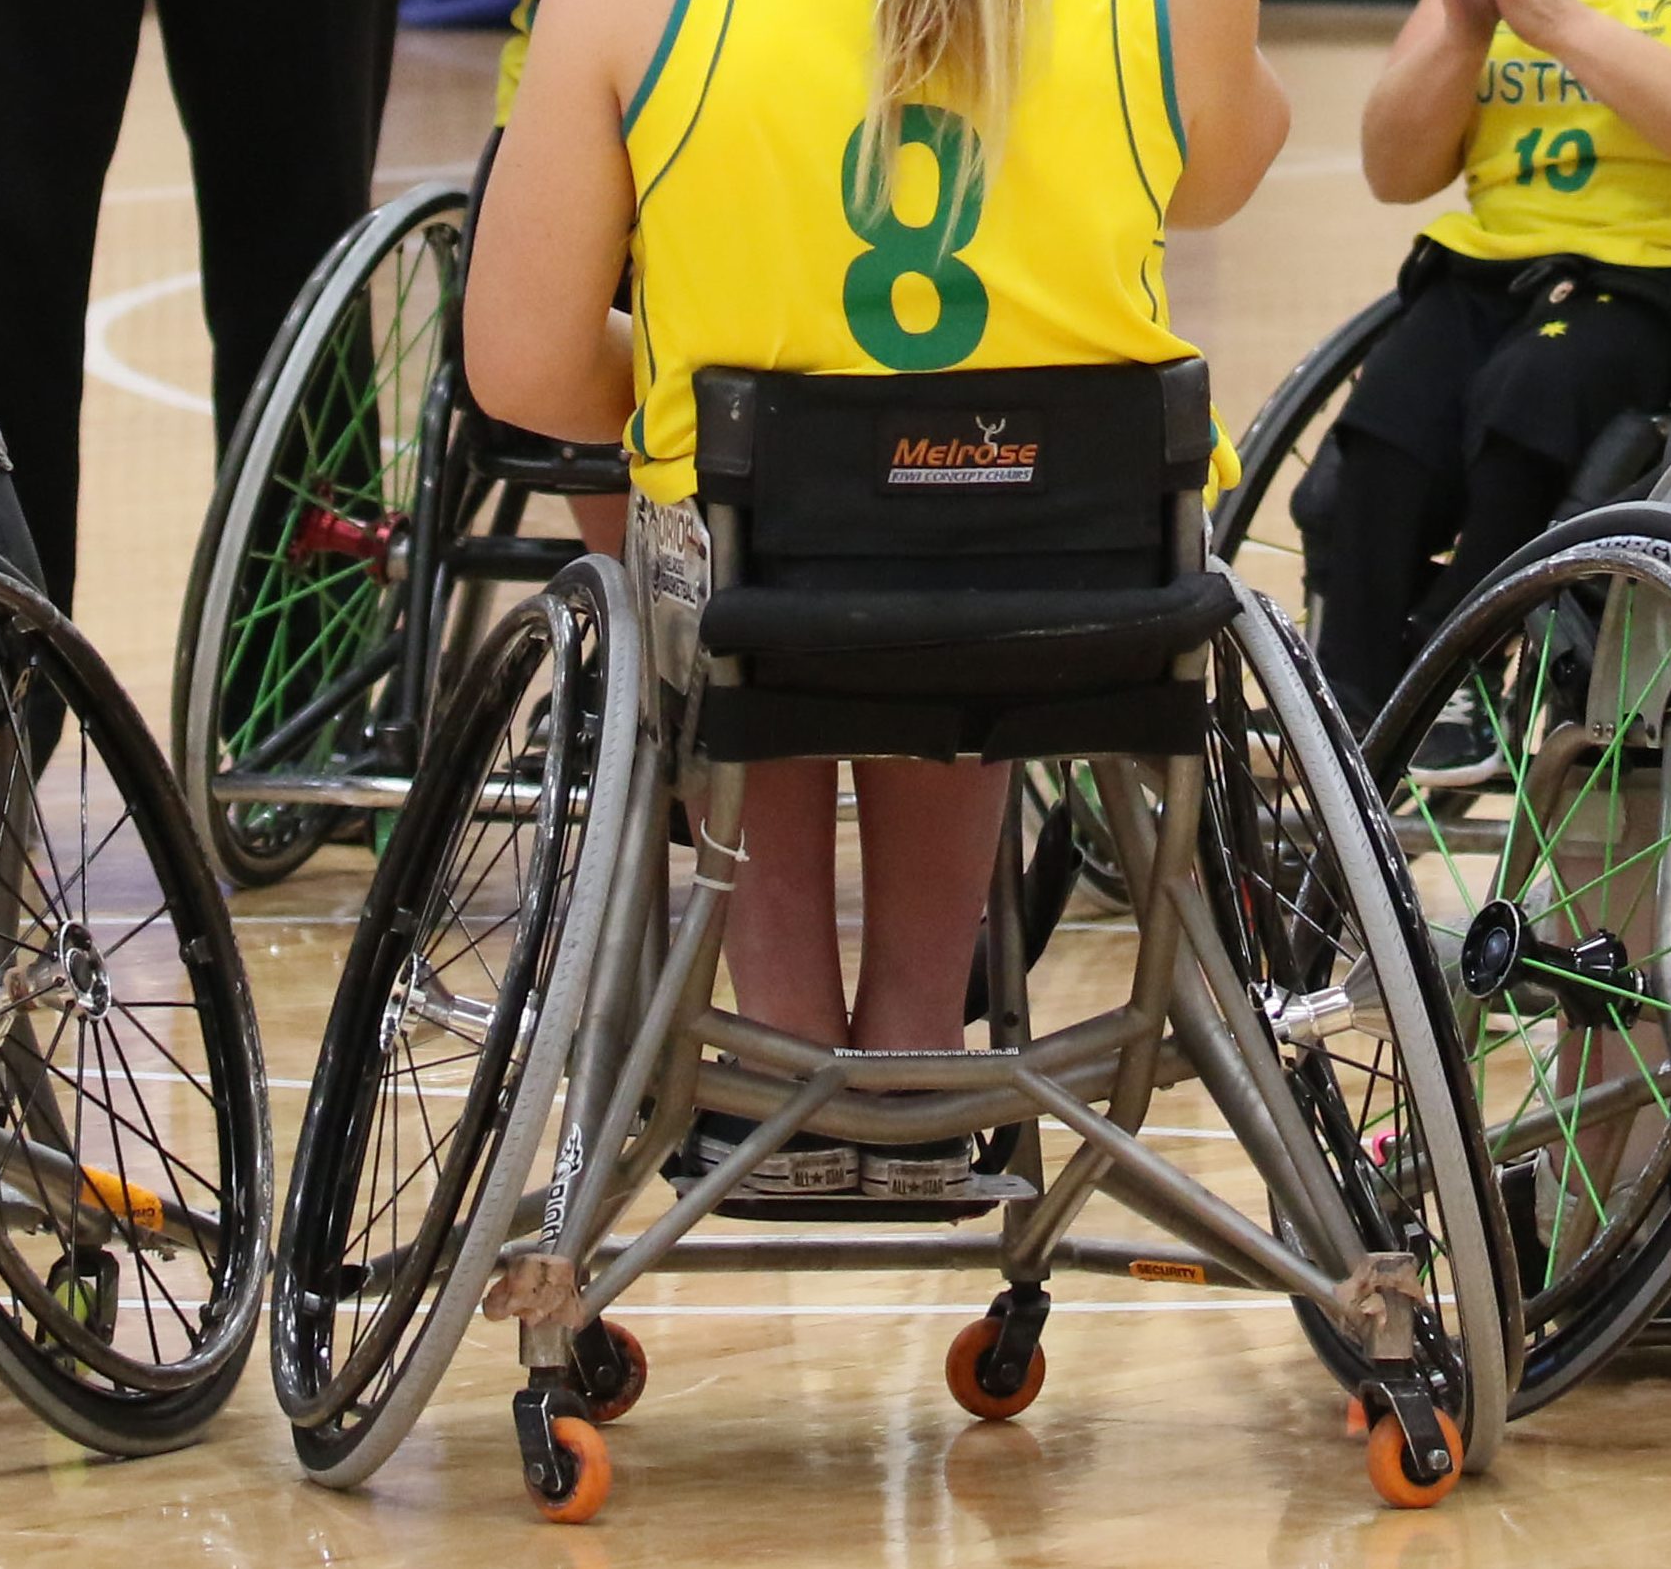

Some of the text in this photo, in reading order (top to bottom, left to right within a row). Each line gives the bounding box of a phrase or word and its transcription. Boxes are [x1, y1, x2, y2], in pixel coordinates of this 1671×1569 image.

[841, 104, 989, 371] 8
[892, 437, 1038, 467] Melrose
[893, 469, 1032, 482] KIWI CONCEPT CHAIRS
[1136, 1263, 1197, 1279] SECURITY
